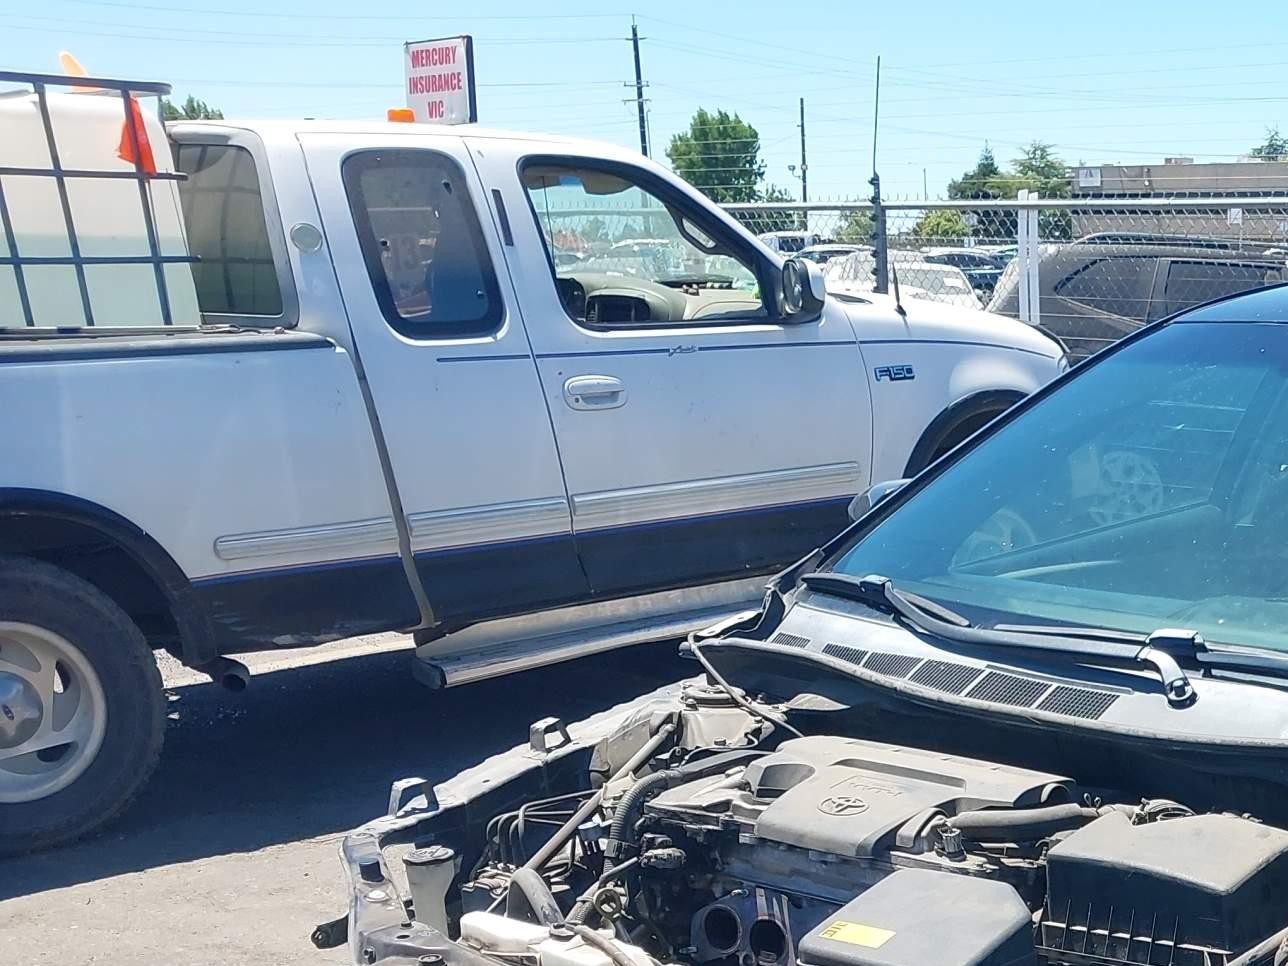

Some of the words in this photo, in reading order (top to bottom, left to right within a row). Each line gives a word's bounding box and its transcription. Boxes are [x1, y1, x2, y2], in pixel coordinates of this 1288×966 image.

[411, 45, 458, 69] MERCURY
[408, 71, 463, 95] INSURANCE
[427, 99, 445, 119] VIC
